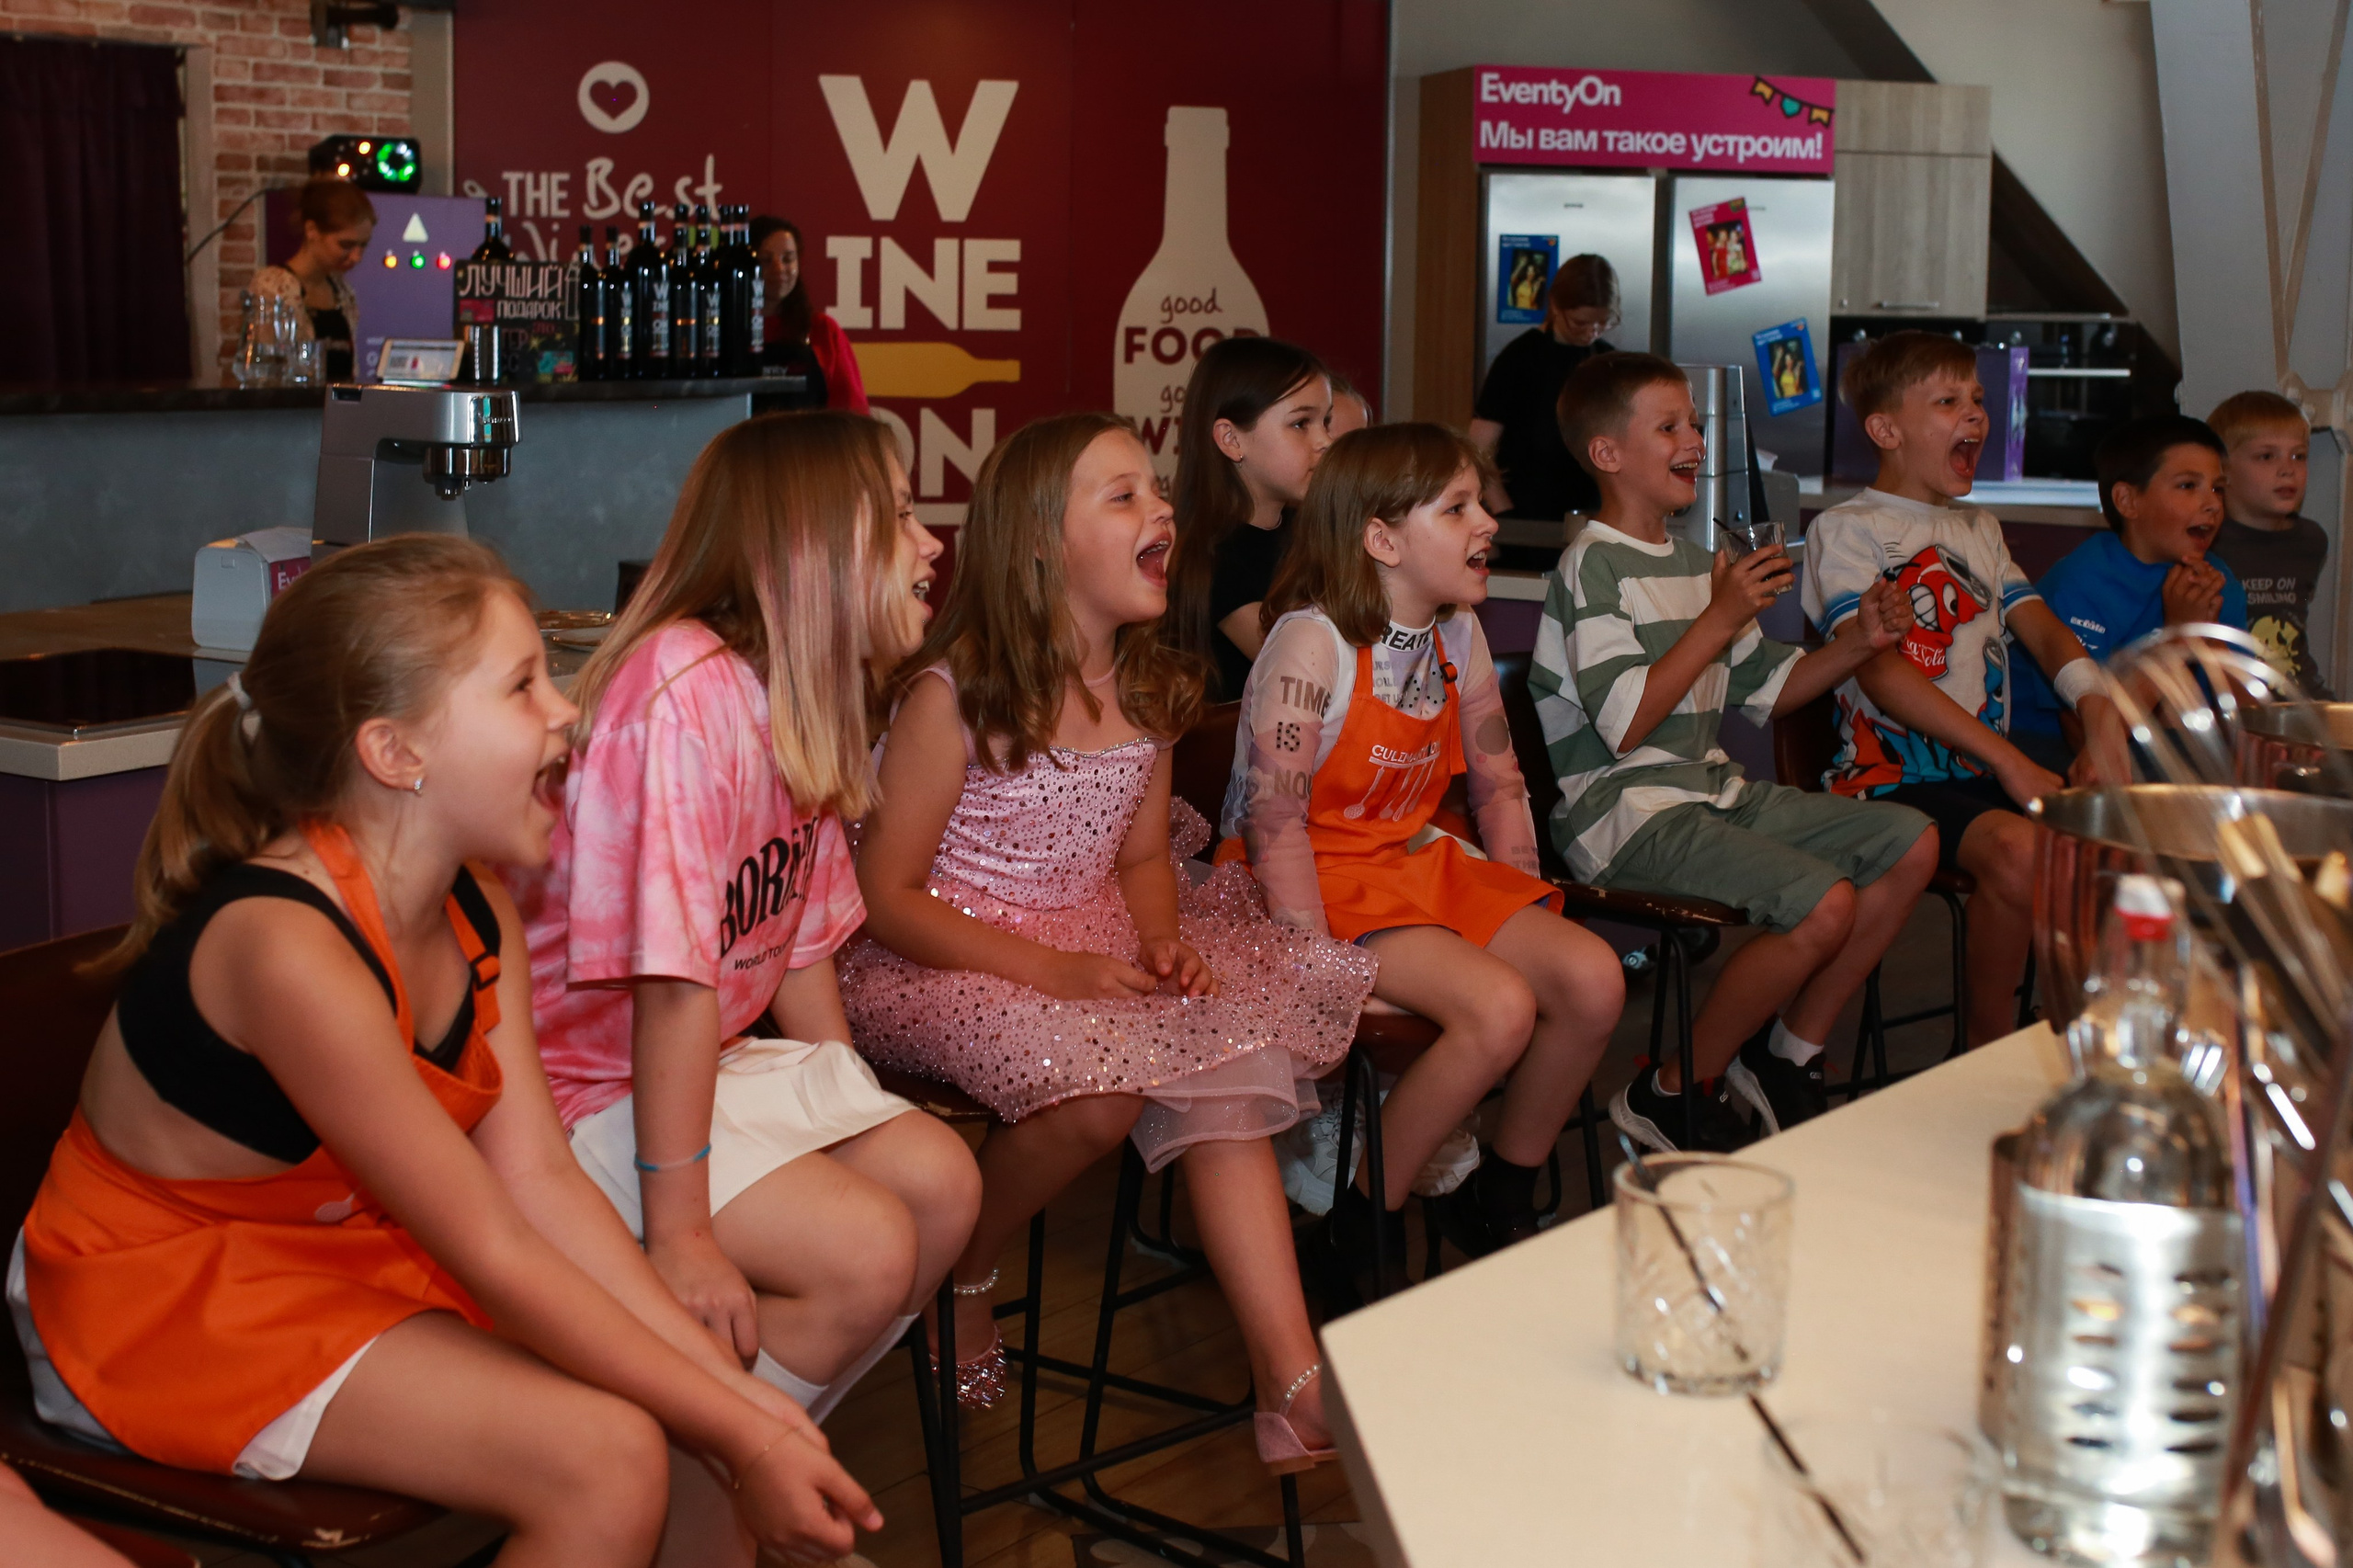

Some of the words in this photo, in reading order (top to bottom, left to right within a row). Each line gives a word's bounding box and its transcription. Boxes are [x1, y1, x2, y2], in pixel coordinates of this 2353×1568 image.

[1480, 73, 1621, 113] EventyOn
[818, 74, 1019, 223] W
[1480, 120, 1533, 150] Мы
[1539, 131, 1598, 151] вам
[1603, 131, 1686, 155] такое
[1692, 132, 1824, 164] устроим!
[502, 171, 571, 219] THE
[583, 153, 723, 221] Best
[459, 264, 563, 299] ЛУЧШИЙ
[825, 236, 1021, 331] INE
[496, 300, 562, 320] ПОДАРОК
[1160, 287, 1223, 324] good
[1124, 326, 1263, 365] FOO
[1160, 384, 1188, 414] go
[2242, 577, 2273, 591] KEEP
[2277, 577, 2297, 590] ON
[1275, 722, 1302, 753] IS
[734, 943, 767, 970] WORLD
